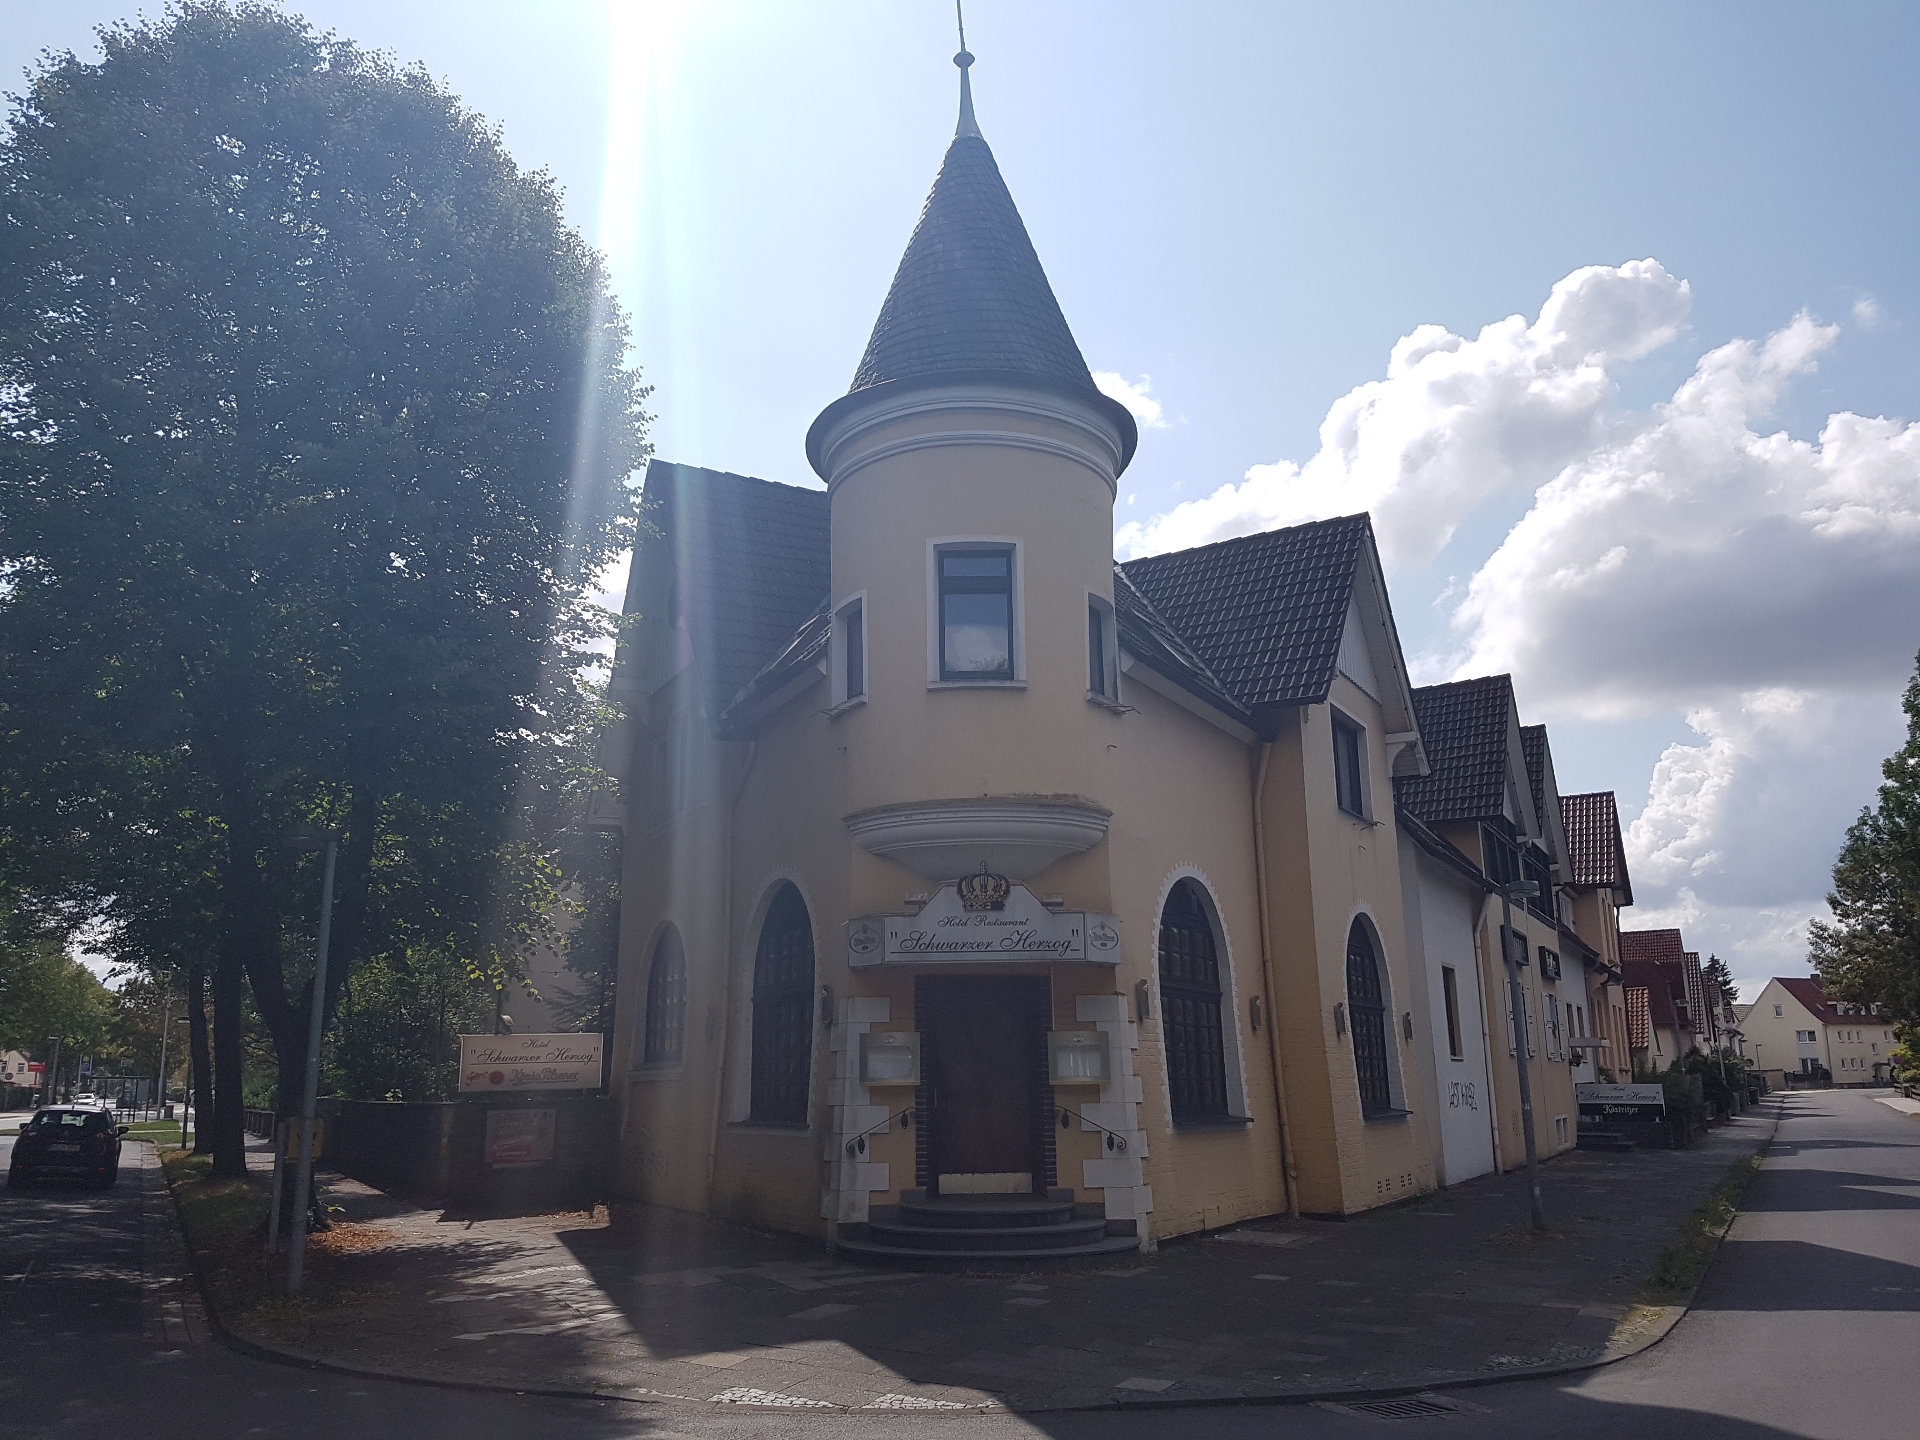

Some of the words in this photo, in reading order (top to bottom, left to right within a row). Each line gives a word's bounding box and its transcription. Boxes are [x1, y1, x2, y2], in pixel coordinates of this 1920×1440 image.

[937, 916, 969, 927] Hotel
[974, 915, 1029, 926] Restaurant
[521, 1038, 552, 1049] Hotel
